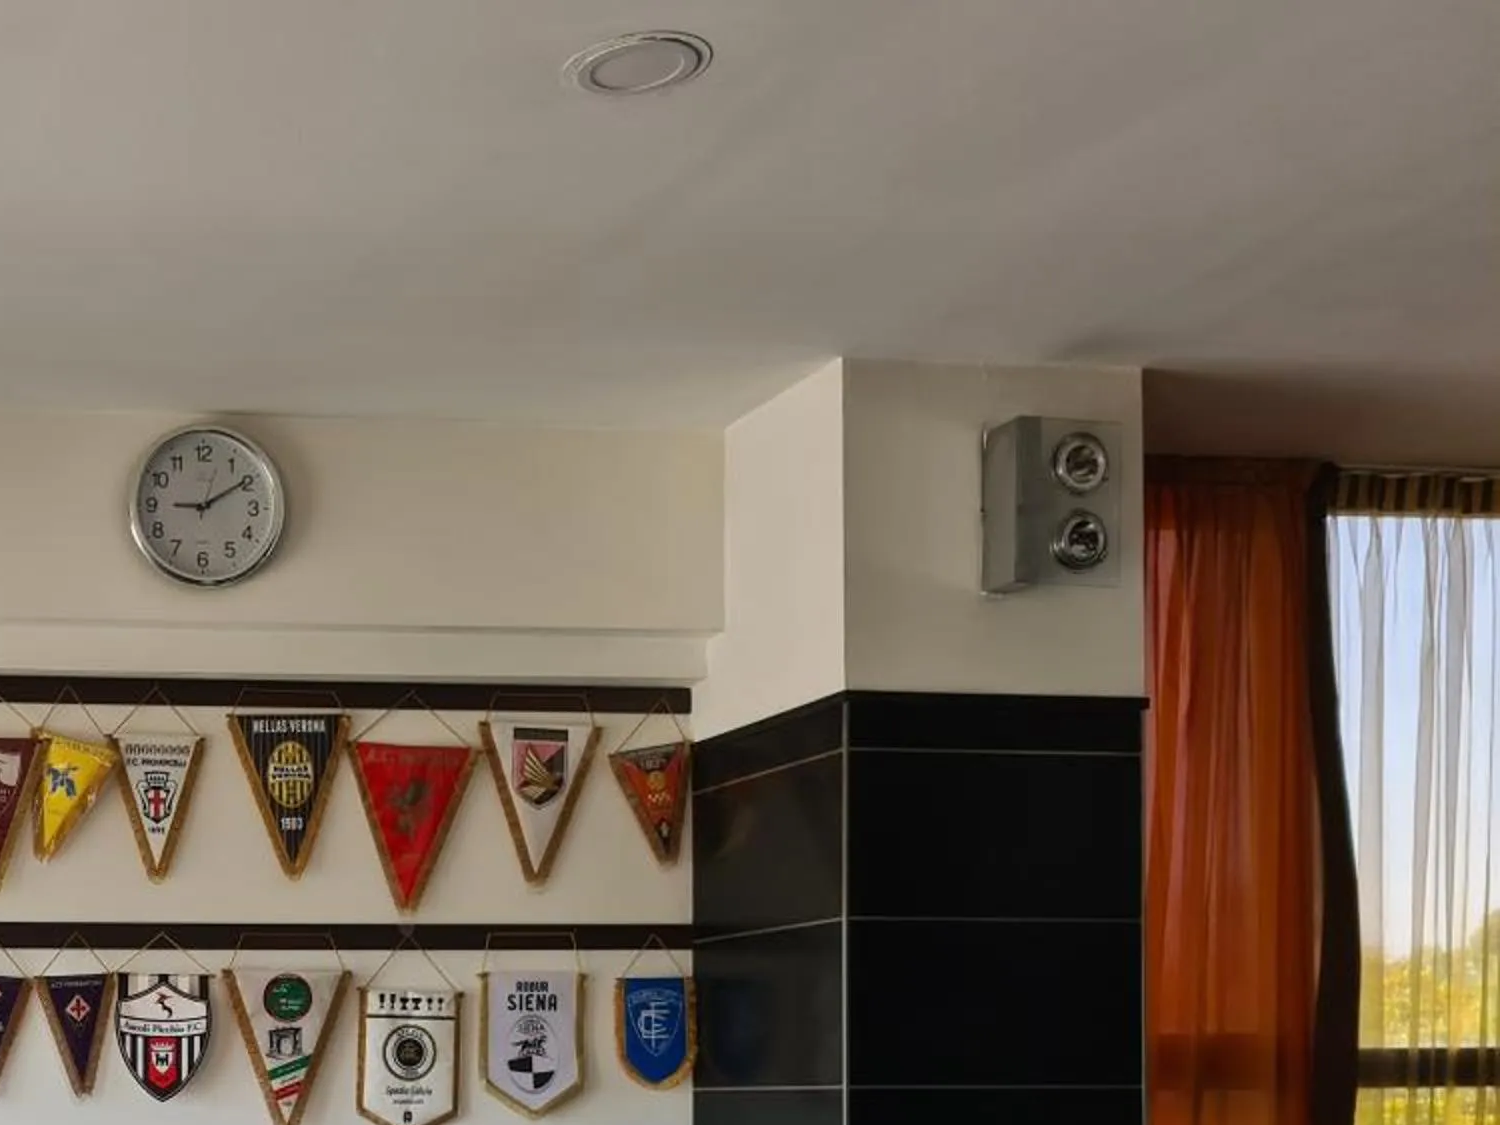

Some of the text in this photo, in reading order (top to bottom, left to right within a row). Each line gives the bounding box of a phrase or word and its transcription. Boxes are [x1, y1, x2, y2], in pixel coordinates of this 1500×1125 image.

[195, 446, 212, 462] 12
[171, 456, 183, 472] 11
[228, 458, 235, 473] 1
[152, 472, 169, 488] 10
[241, 475, 254, 492] 2
[146, 497, 158, 513] 9
[247, 500, 260, 517] 3
[152, 522, 164, 539] 8
[242, 526, 253, 540] 4
[170, 539, 182, 556] 7
[225, 541, 236, 558] 5
[197, 552, 209, 568] 6
[507, 993, 558, 1012] SIENA
